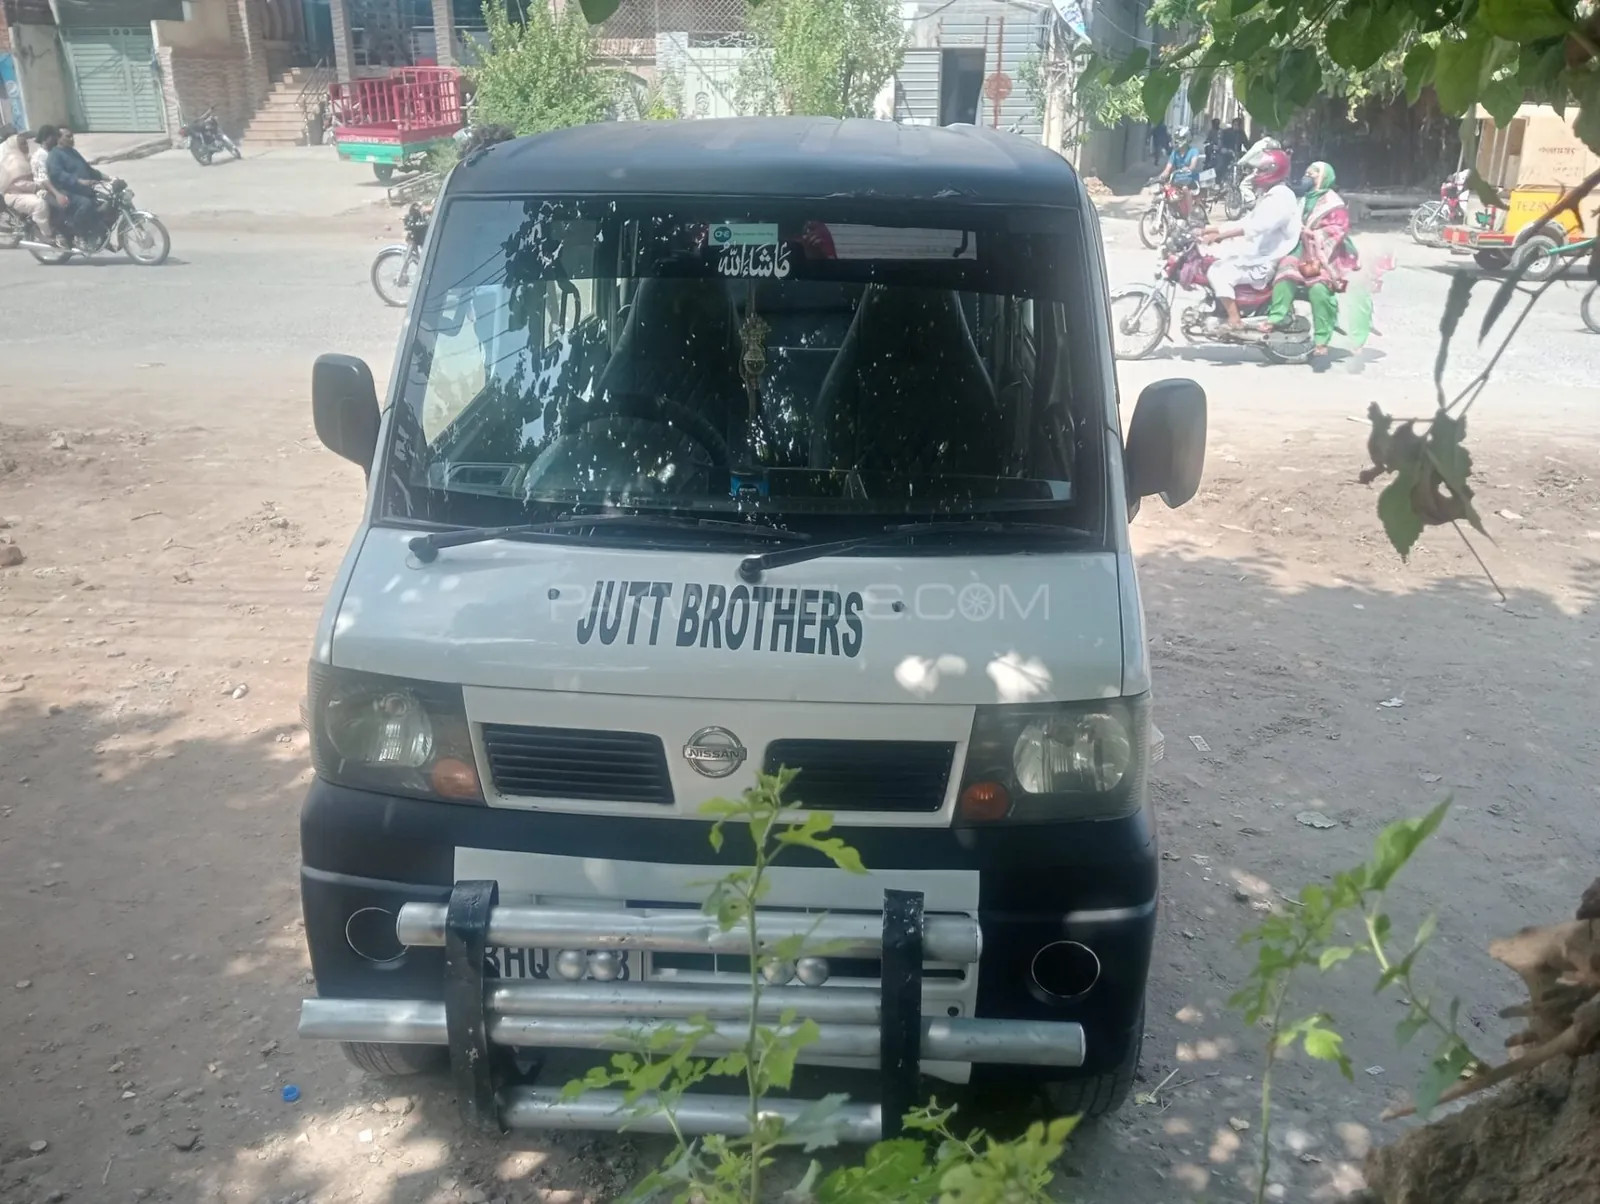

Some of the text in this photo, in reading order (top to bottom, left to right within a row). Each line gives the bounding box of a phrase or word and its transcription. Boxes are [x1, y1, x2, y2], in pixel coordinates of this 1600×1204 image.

[577, 581, 864, 658] JUTT BROTHERS
[687, 747, 741, 759] NISSAN
